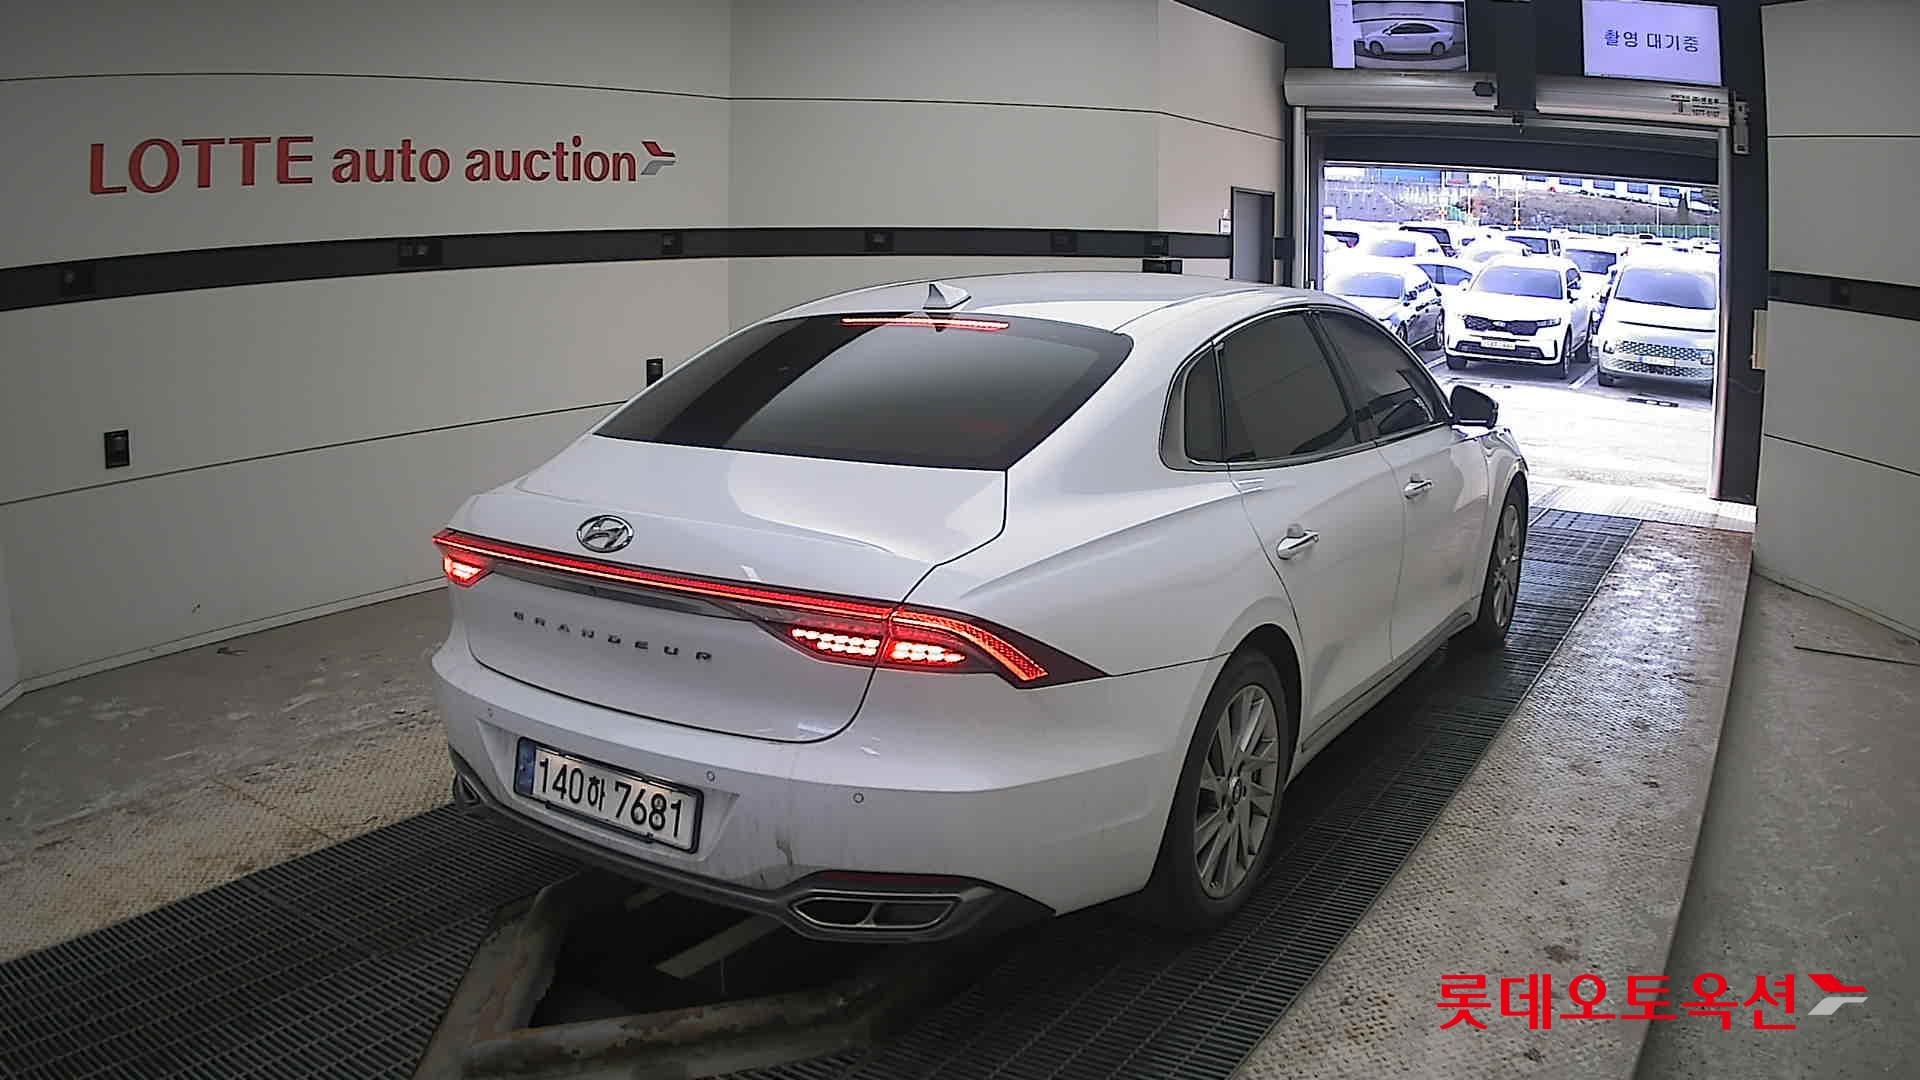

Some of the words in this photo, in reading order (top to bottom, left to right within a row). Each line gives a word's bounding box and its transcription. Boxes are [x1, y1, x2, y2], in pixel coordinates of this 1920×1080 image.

[1604, 30, 1639, 48] 촬영
[1647, 33, 1699, 53] 대기중
[89, 136, 314, 194] LOTTE
[331, 138, 450, 184] auto
[464, 135, 638, 184] auction
[513, 611, 712, 661] GRANDEUR
[539, 757, 606, 812] 140하
[614, 782, 682, 838] 7681
